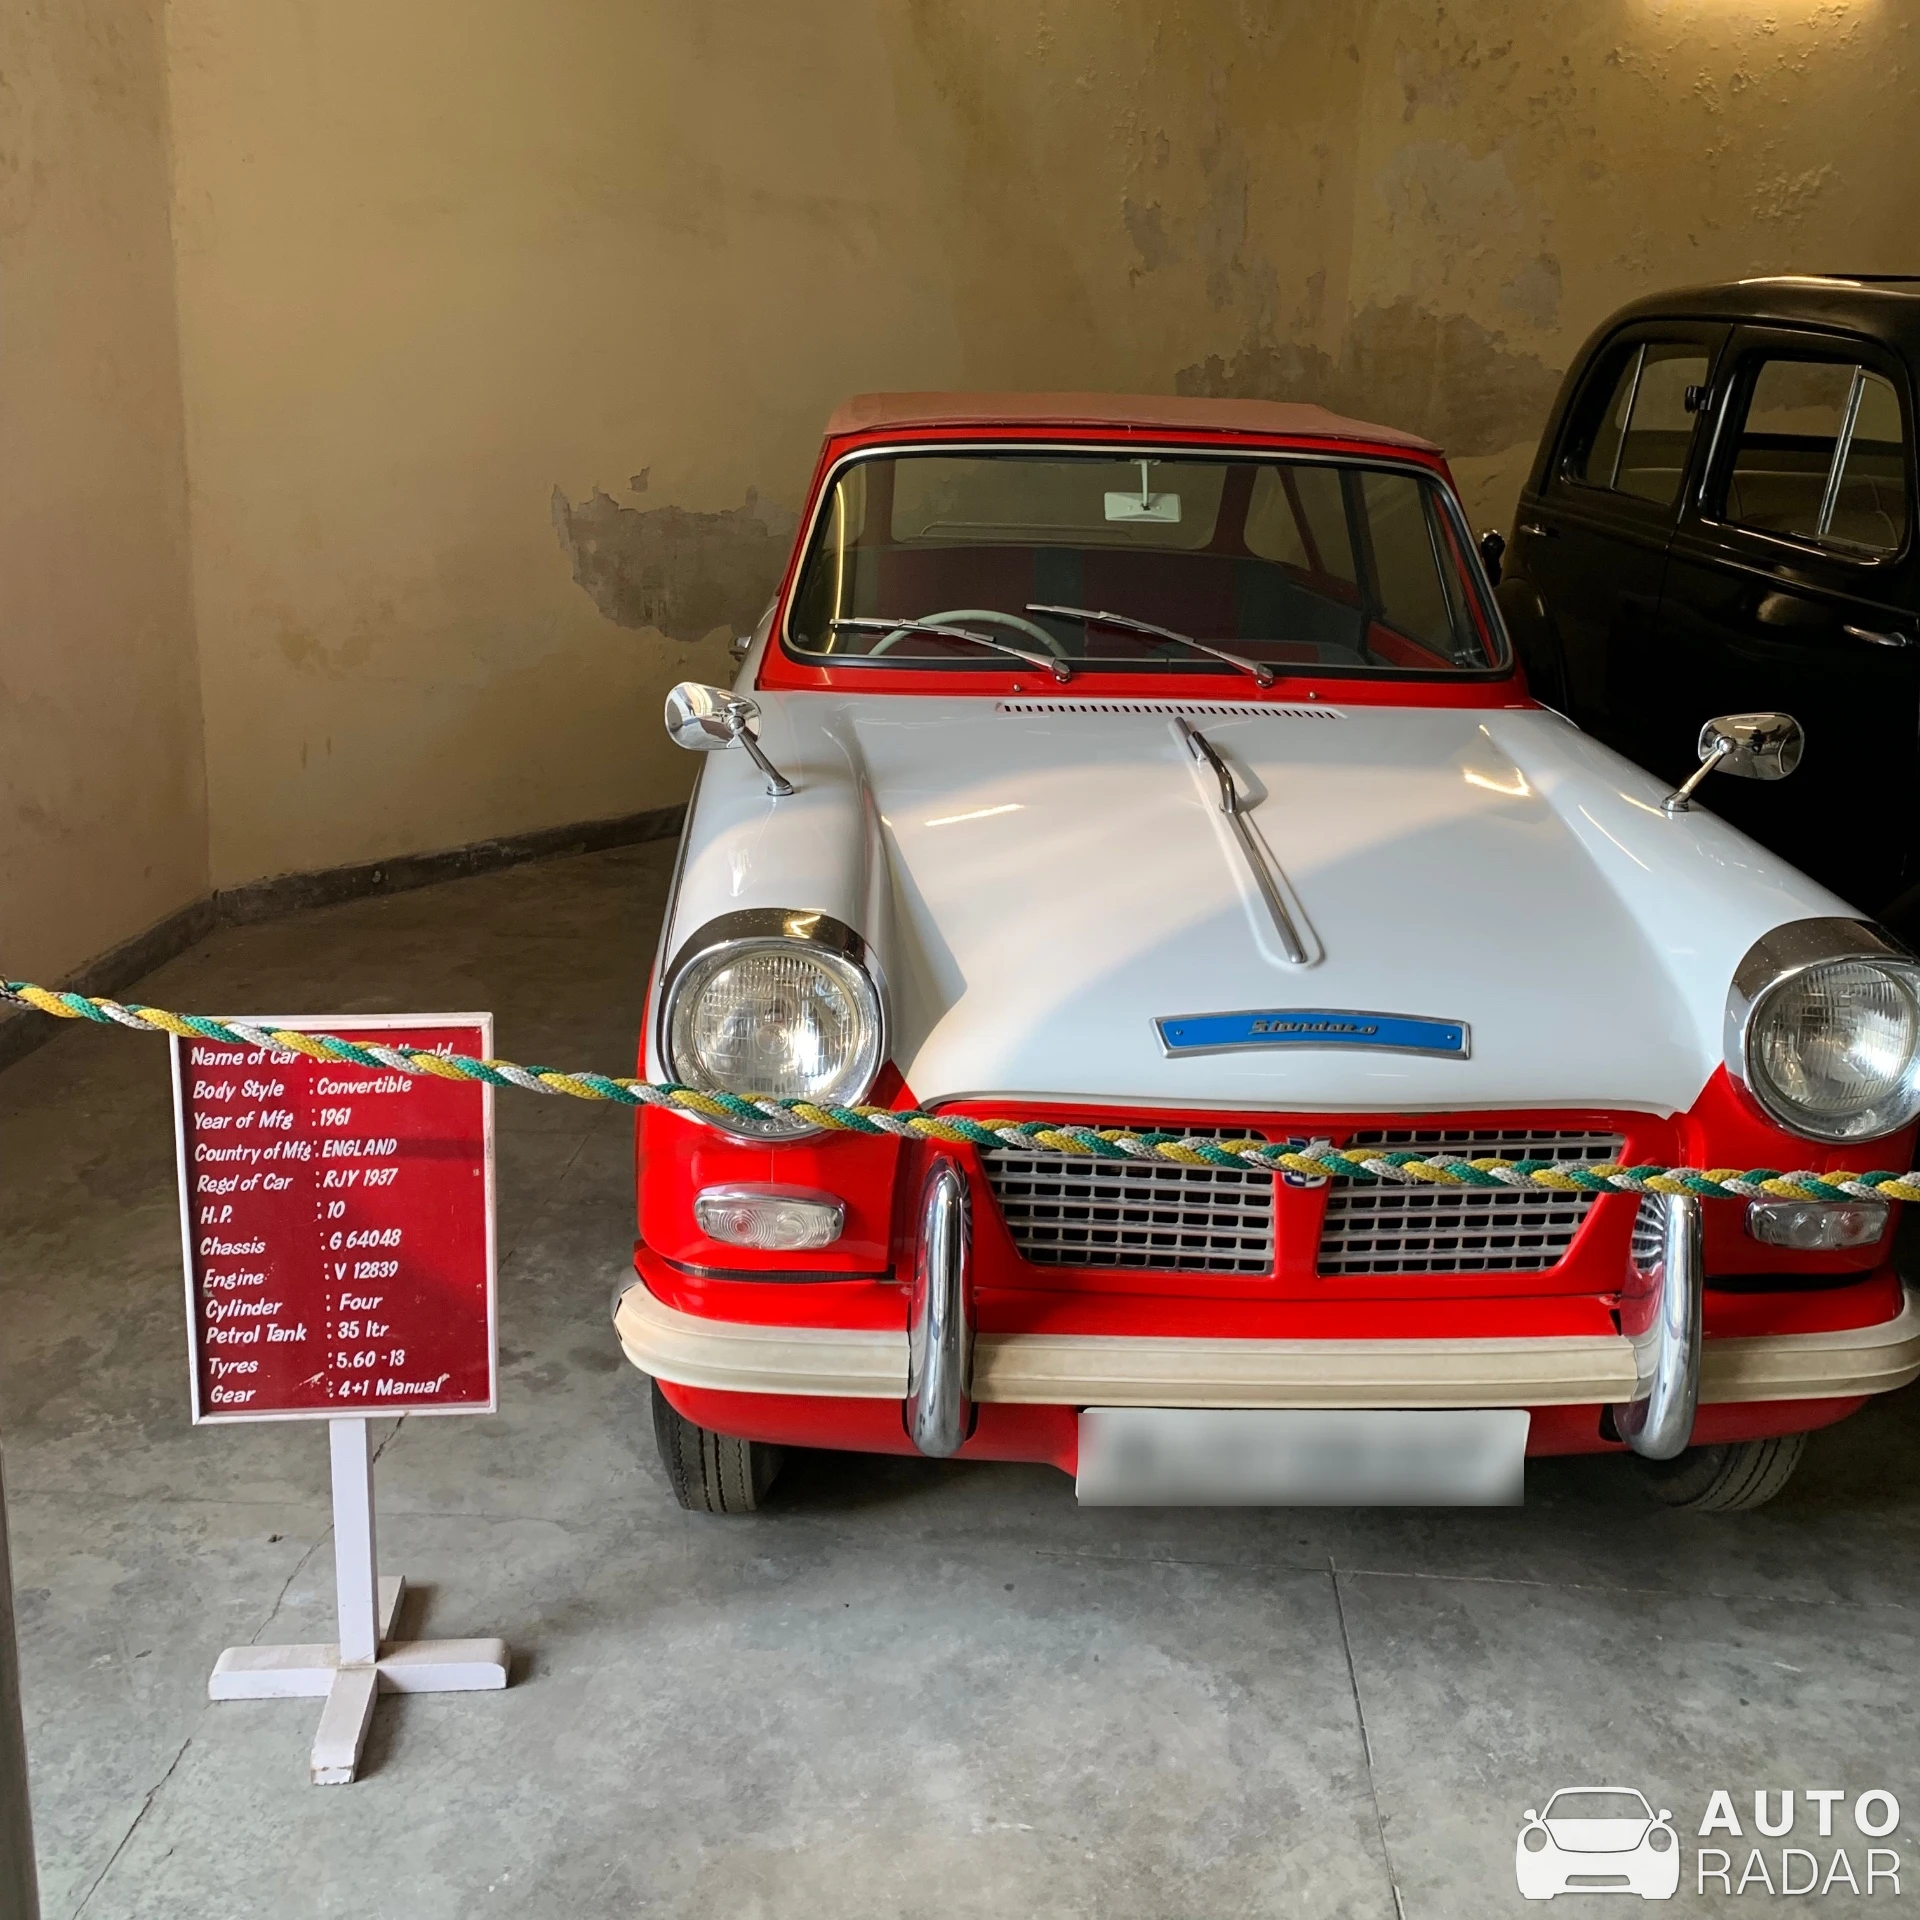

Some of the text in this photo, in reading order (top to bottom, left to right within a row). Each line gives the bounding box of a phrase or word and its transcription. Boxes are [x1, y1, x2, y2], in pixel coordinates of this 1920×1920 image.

[191, 1047, 244, 1066] Name
[247, 1047, 266, 1065] of
[270, 1051, 301, 1065] Car
[193, 1080, 237, 1103] Body
[241, 1078, 285, 1103] Style
[316, 1075, 413, 1097] Convertible
[194, 1111, 232, 1130] Year
[235, 1110, 256, 1129] of
[258, 1109, 294, 1131] Mfg
[320, 1107, 352, 1127] 1961
[194, 1142, 260, 1166] Country
[263, 1140, 283, 1160] of
[282, 1140, 312, 1162] Mfg
[322, 1138, 398, 1158] ENGLAND
[197, 1173, 239, 1196] Regd
[240, 1172, 261, 1192] of
[262, 1172, 294, 1191] Car
[323, 1169, 359, 1188] RJY
[363, 1167, 399, 1187] 1937
[200, 1204, 233, 1225] H.P.
[327, 1200, 346, 1219] 10
[200, 1235, 266, 1256] Chassis
[346, 1228, 402, 1249] 64048
[202, 1267, 265, 1290] Engine
[334, 1262, 347, 1281] V
[353, 1260, 399, 1280] 12839
[205, 1297, 283, 1323] Cylinder
[339, 1292, 384, 1311] Four
[205, 1324, 260, 1344] Petrol
[265, 1322, 308, 1342] Tank
[337, 1320, 360, 1339] 35
[365, 1319, 390, 1338] ltr
[208, 1357, 259, 1380] Tyres
[210, 1384, 257, 1404] Gear
[338, 1378, 369, 1397] 4+1
[375, 1376, 444, 1397] Manual
